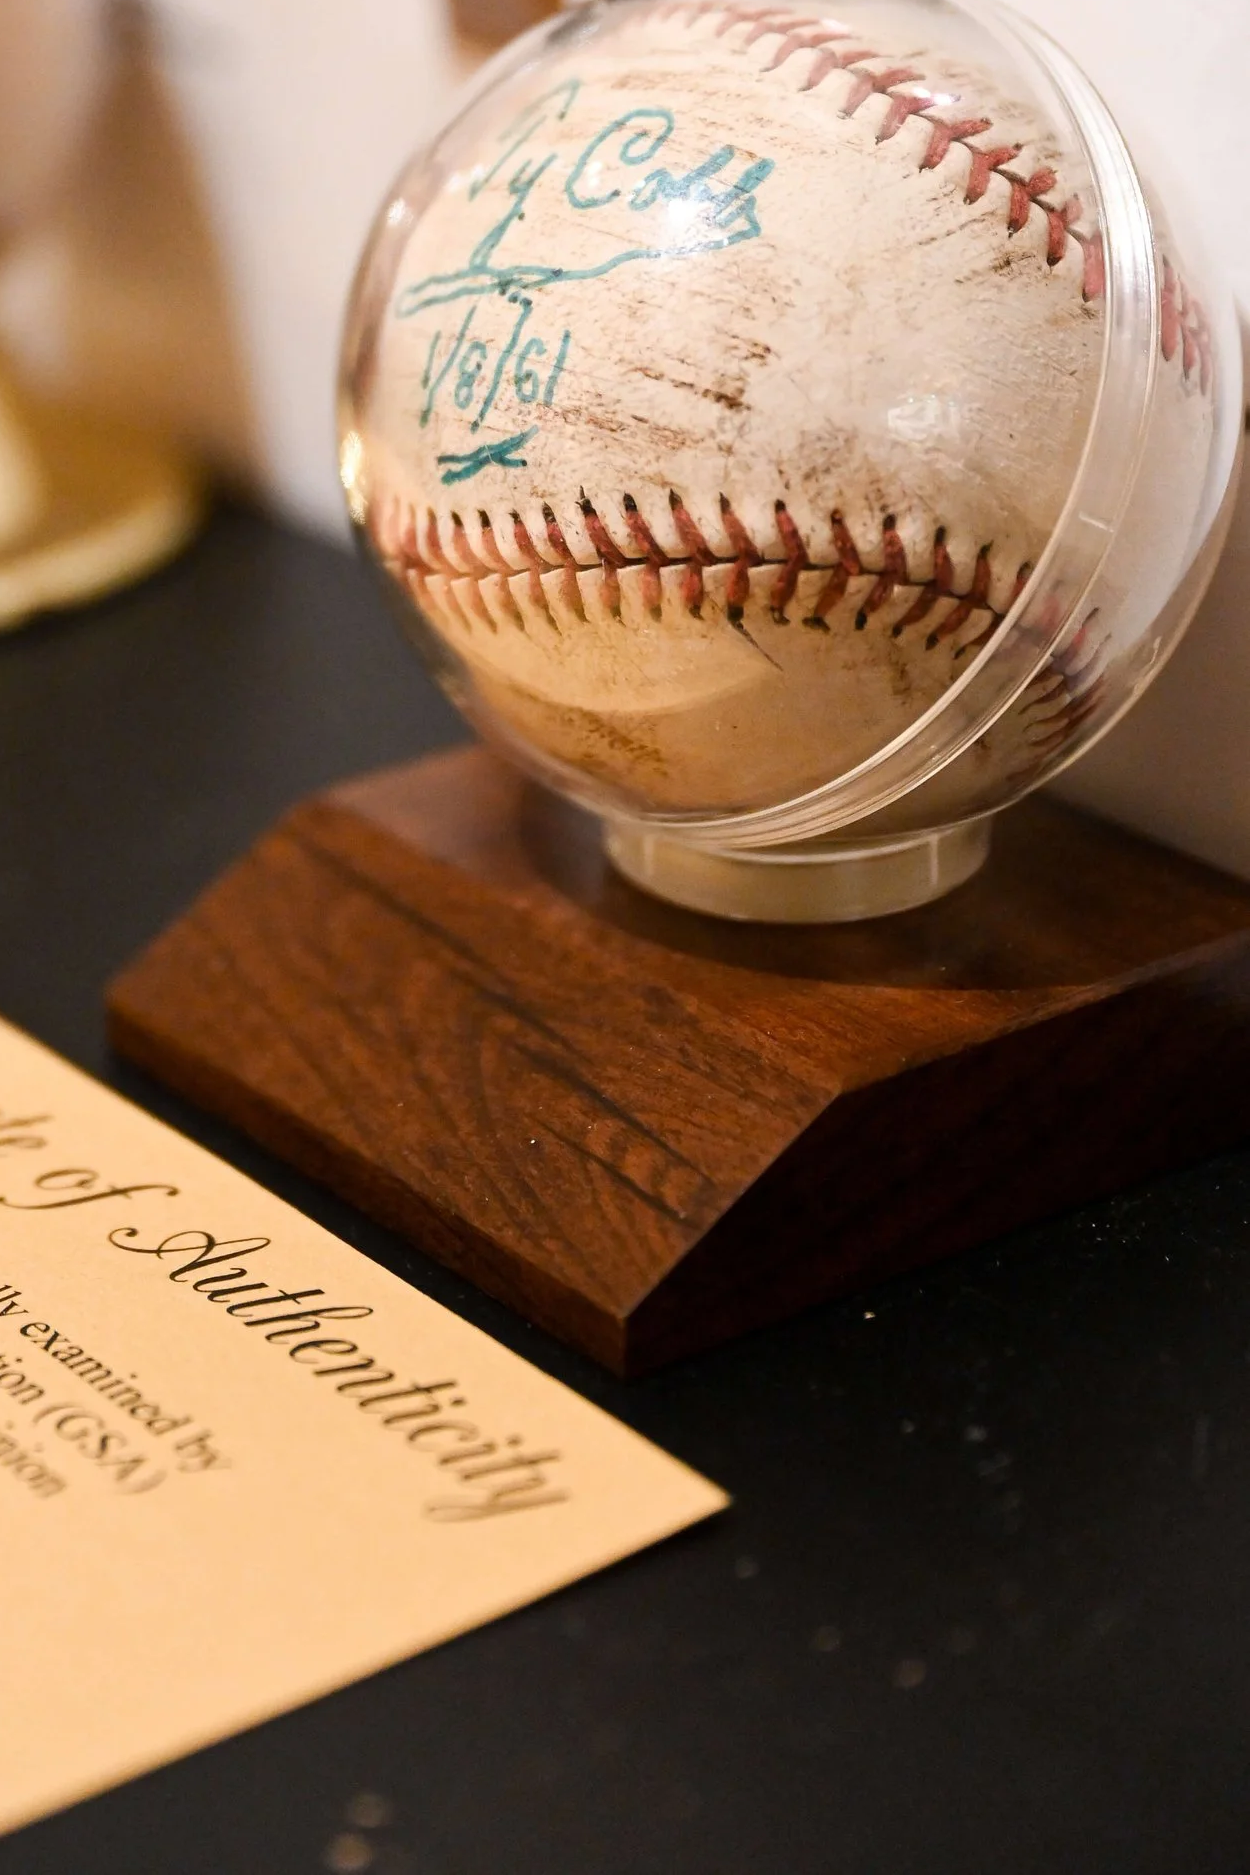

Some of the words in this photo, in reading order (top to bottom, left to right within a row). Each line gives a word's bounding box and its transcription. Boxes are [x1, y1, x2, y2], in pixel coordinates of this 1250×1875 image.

[19, 1321, 194, 1436] examined
[174, 1428, 232, 1473] by
[33, 1401, 168, 1496] (GSA)
[108, 1227, 571, 1523] Authenticity
